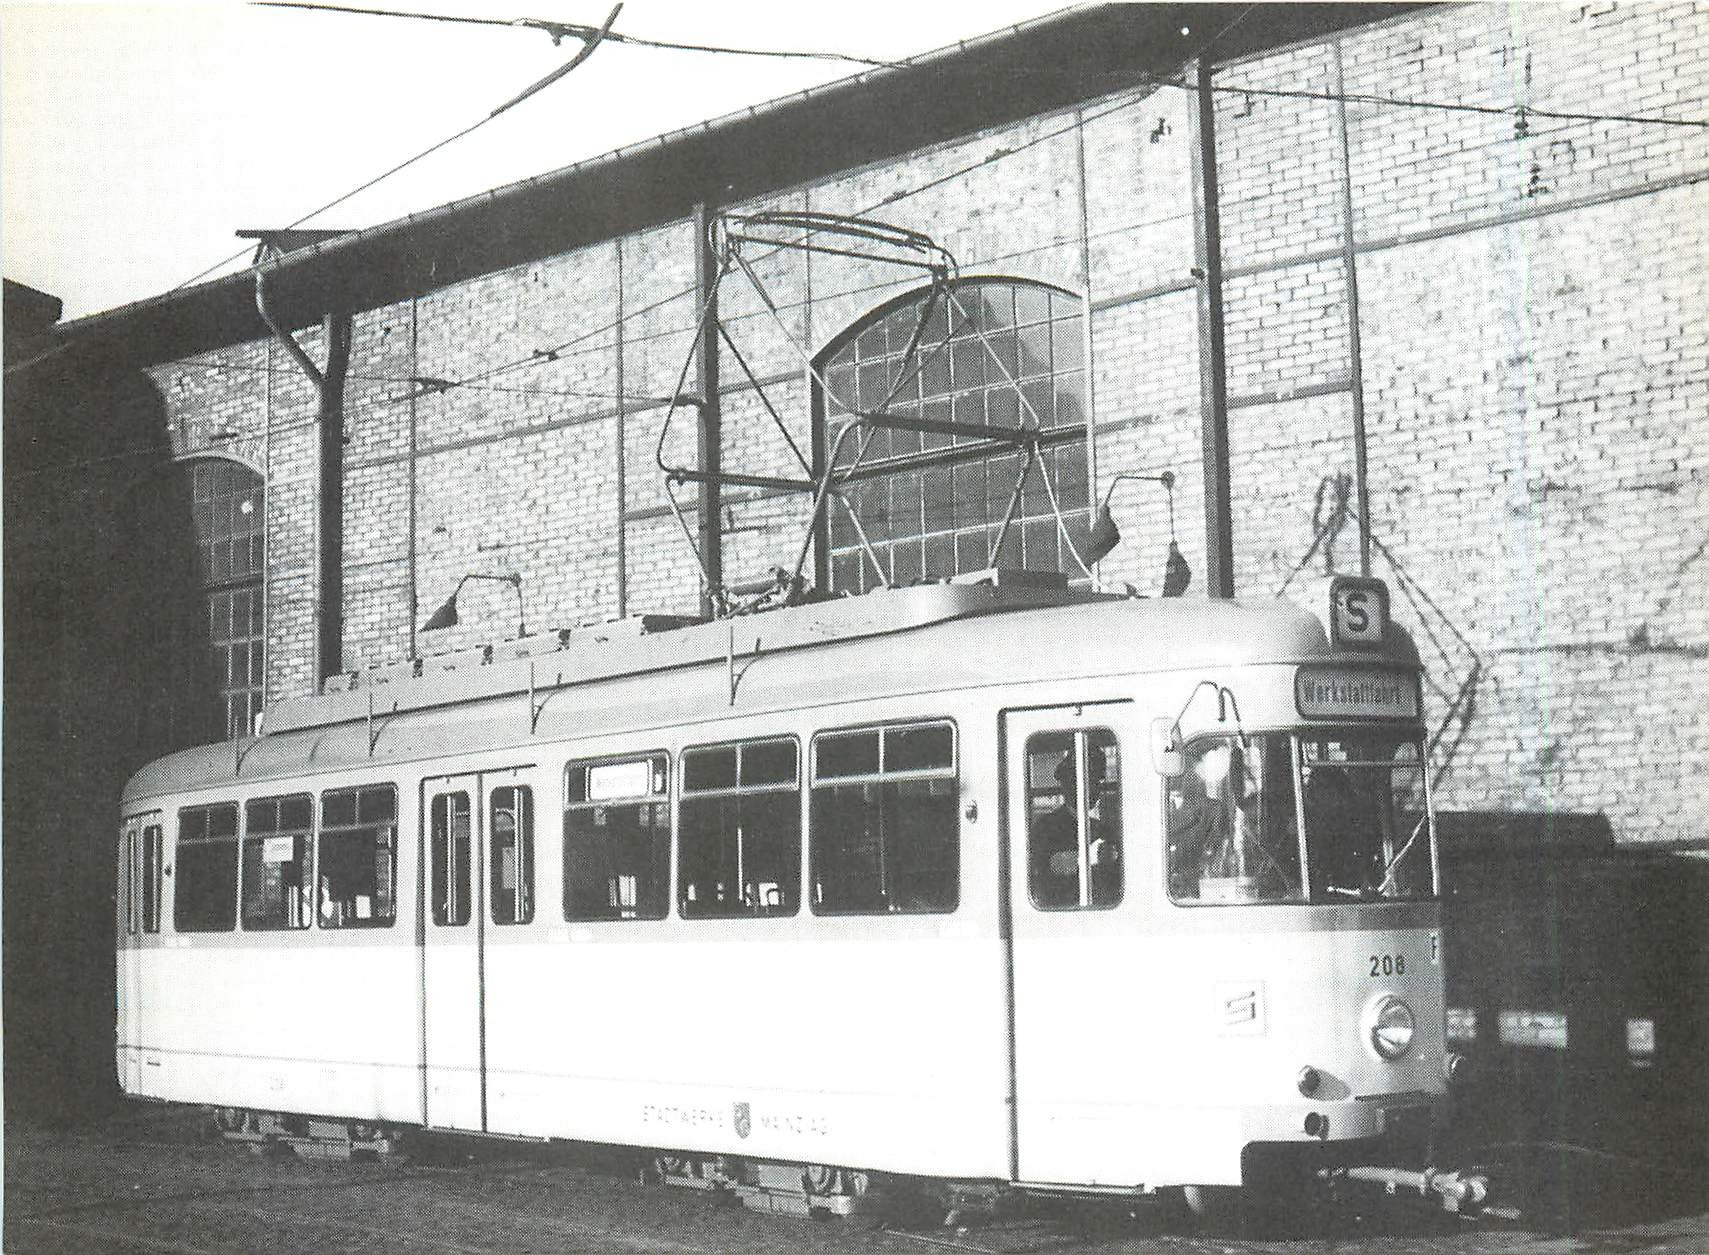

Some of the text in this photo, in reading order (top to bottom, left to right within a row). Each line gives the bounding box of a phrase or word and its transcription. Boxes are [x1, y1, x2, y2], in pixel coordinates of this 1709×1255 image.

[1346, 592, 1369, 633] S
[1303, 680, 1401, 705] Werkstattfahrt
[1369, 955, 1405, 978] 208
[760, 1114, 803, 1135] MANZ
